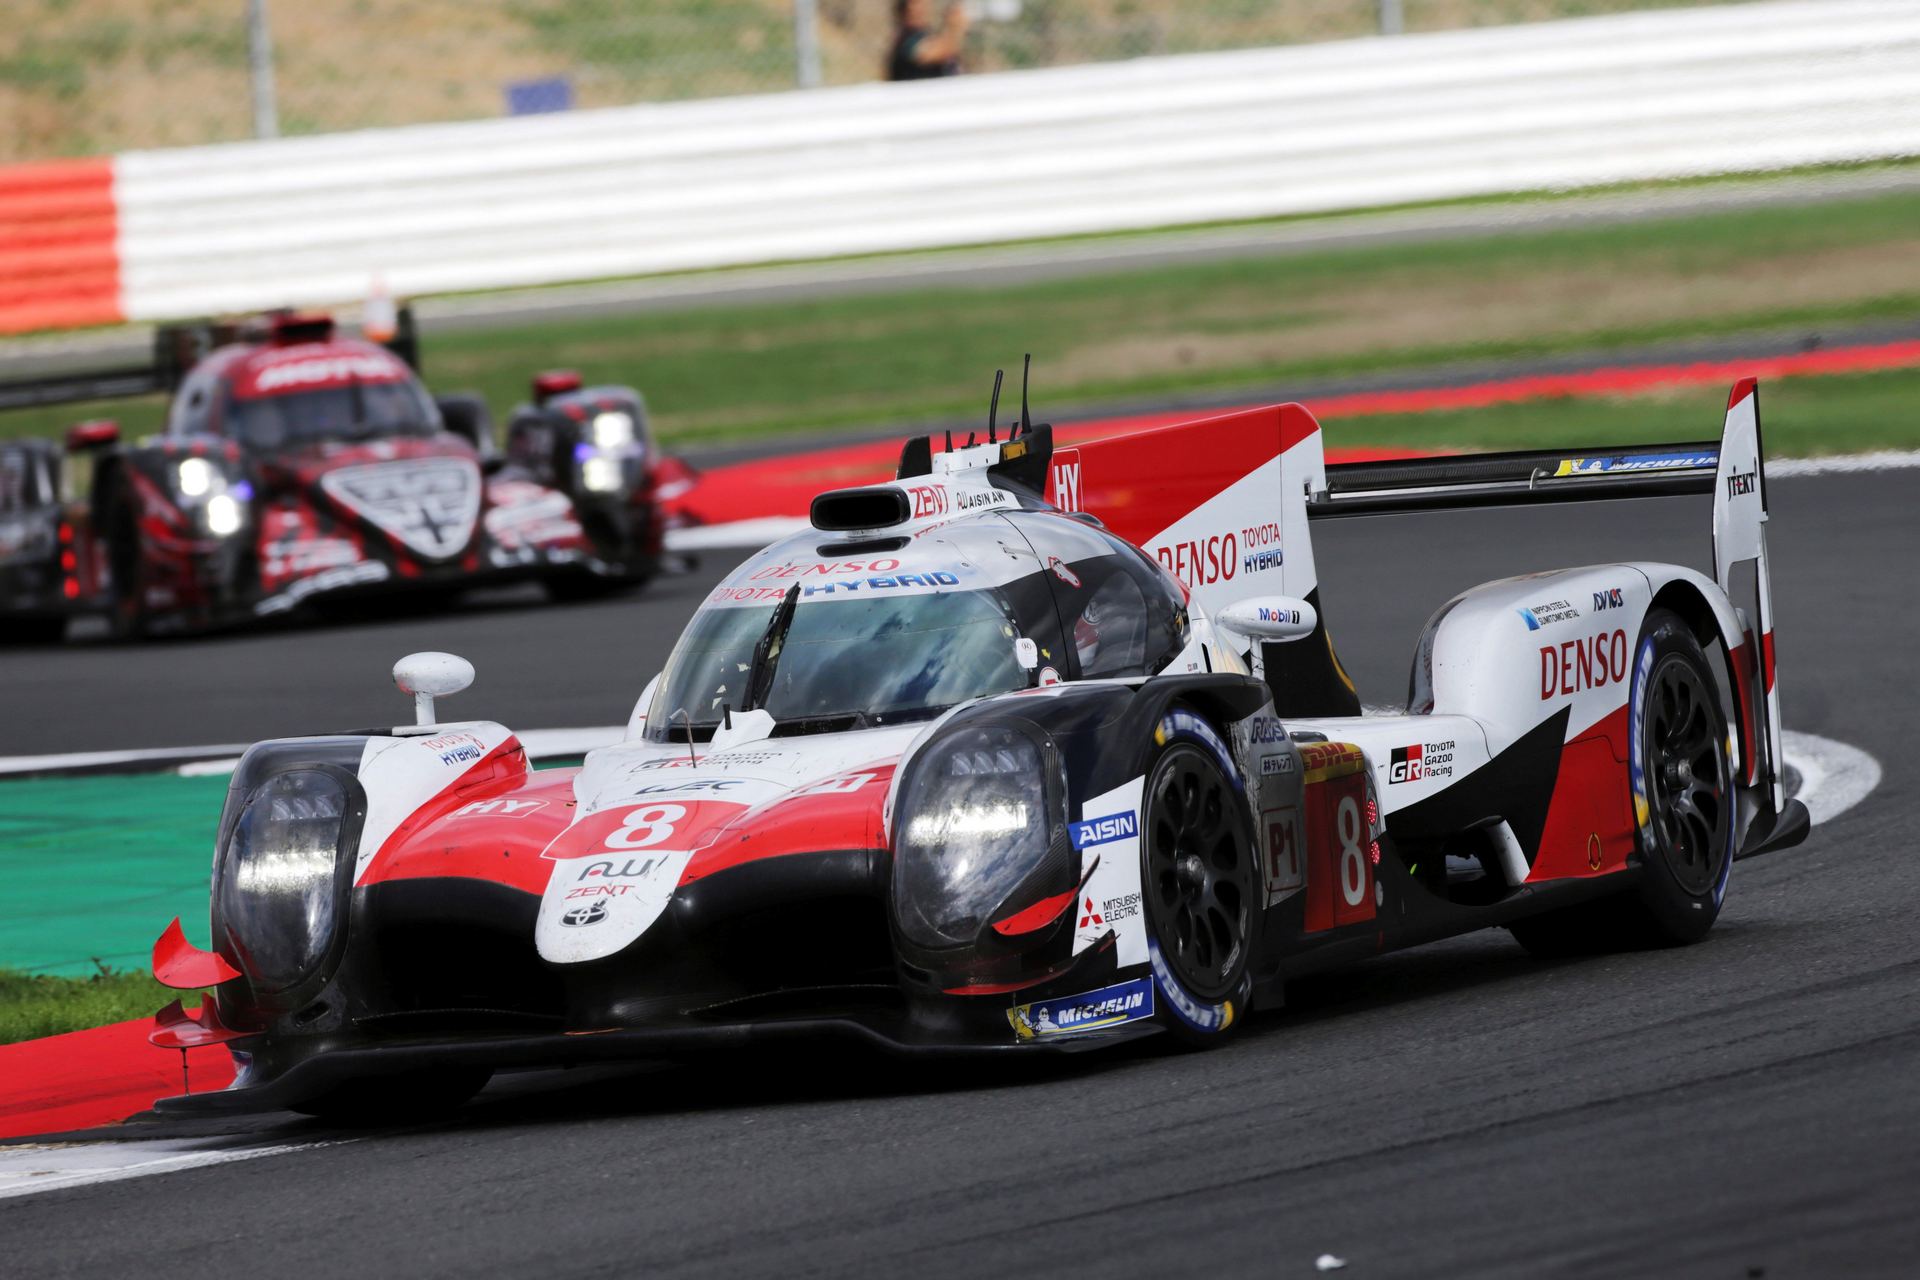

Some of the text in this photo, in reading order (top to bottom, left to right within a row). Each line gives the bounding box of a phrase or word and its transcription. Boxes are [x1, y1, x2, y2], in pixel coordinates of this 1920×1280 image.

[968, 493, 992, 508] AISIN
[992, 489, 1006, 503] AW
[1054, 463, 1080, 513] HY
[1727, 472, 1756, 501] JTEKT
[907, 484, 950, 519] ZENT
[1242, 522, 1281, 549] TOYOTA
[750, 559, 901, 581] DENSO
[1244, 549, 1283, 574] HYBRID
[803, 571, 960, 598] HYBRID
[1258, 608, 1291, 623] Mobil
[1531, 604, 1553, 616] NIPPON
[1550, 601, 1565, 611] STEEL
[1564, 609, 1581, 619] METAL
[1540, 629, 1627, 700] DENSO
[1251, 717, 1286, 743] RAYS
[438, 745, 481, 766] HYBRID
[1424, 740, 1455, 754] TOYOTA
[1424, 753, 1453, 766] GAZOO
[1390, 758, 1422, 783] GR
[1424, 764, 1453, 778] Racing
[457, 799, 544, 815] HY
[604, 804, 688, 849] 8
[1079, 815, 1134, 845] AISIN
[1269, 821, 1298, 878] P1
[1337, 796, 1366, 906] 8
[565, 885, 636, 900] ZENT
[1103, 892, 1141, 911] MITSUBISH
[1104, 905, 1139, 923] ELECTRIC
[1058, 992, 1144, 1024] MICHELIN
